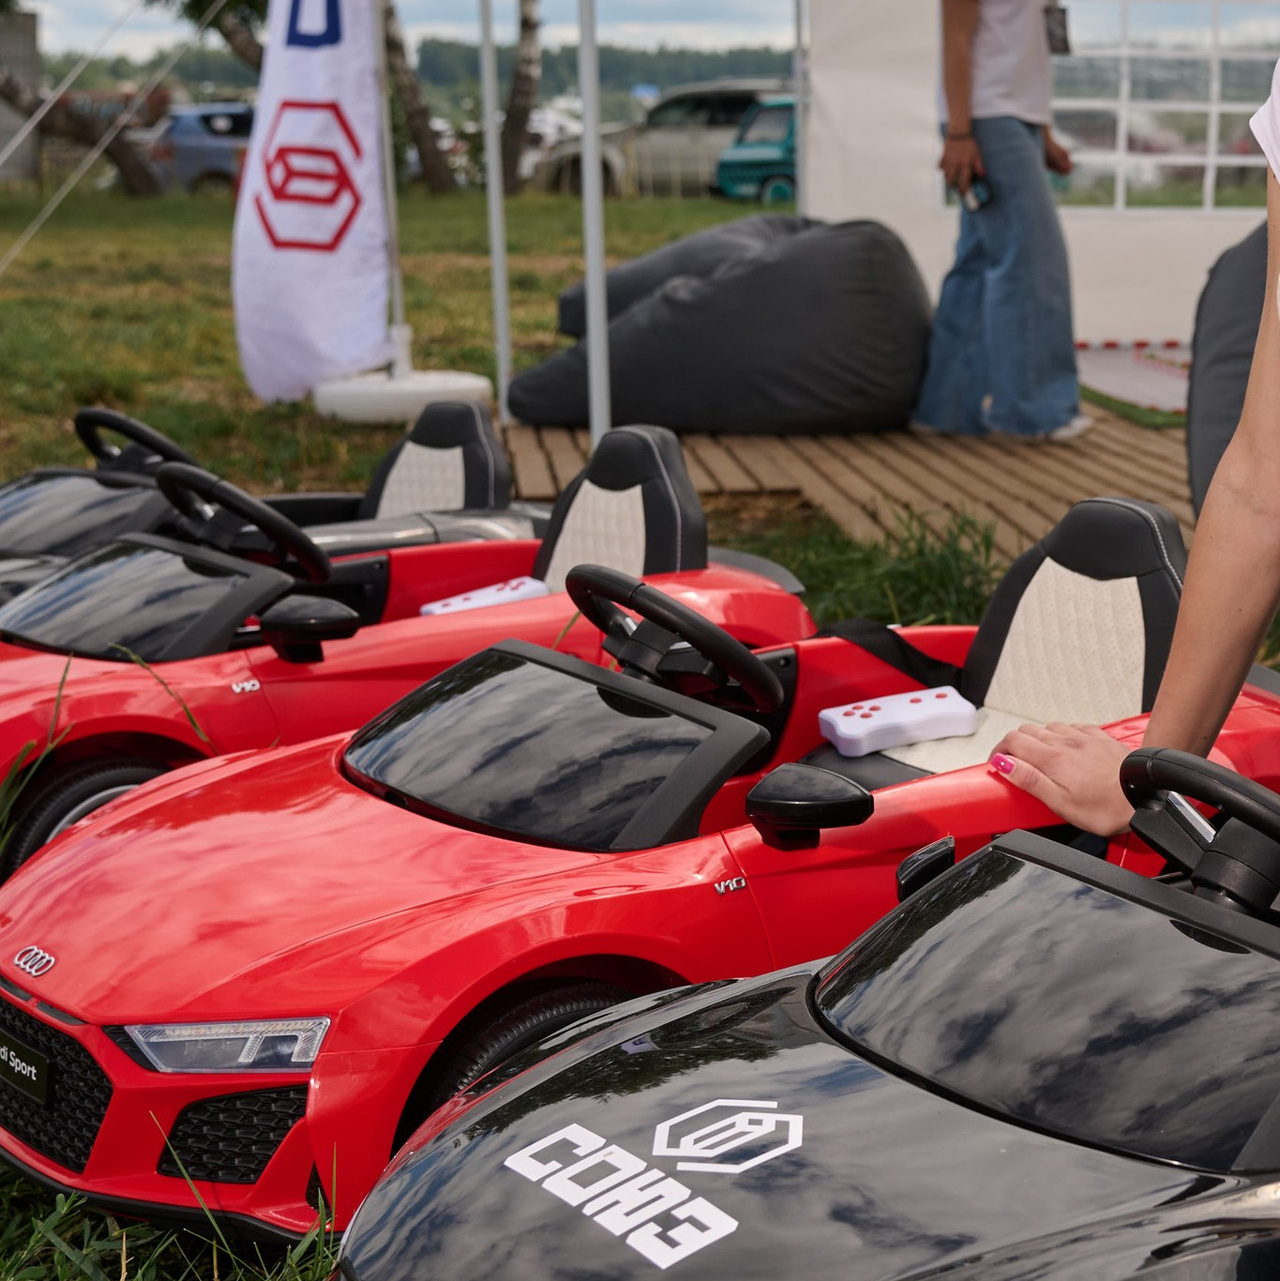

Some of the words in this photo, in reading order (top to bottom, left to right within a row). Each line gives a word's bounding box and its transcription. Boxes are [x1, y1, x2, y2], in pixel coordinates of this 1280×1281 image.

[714, 877, 746, 895] V10
[0, 1045, 8, 1061] di
[9, 1051, 37, 1080] Sport
[503, 1123, 739, 1270] СОЮЗ
